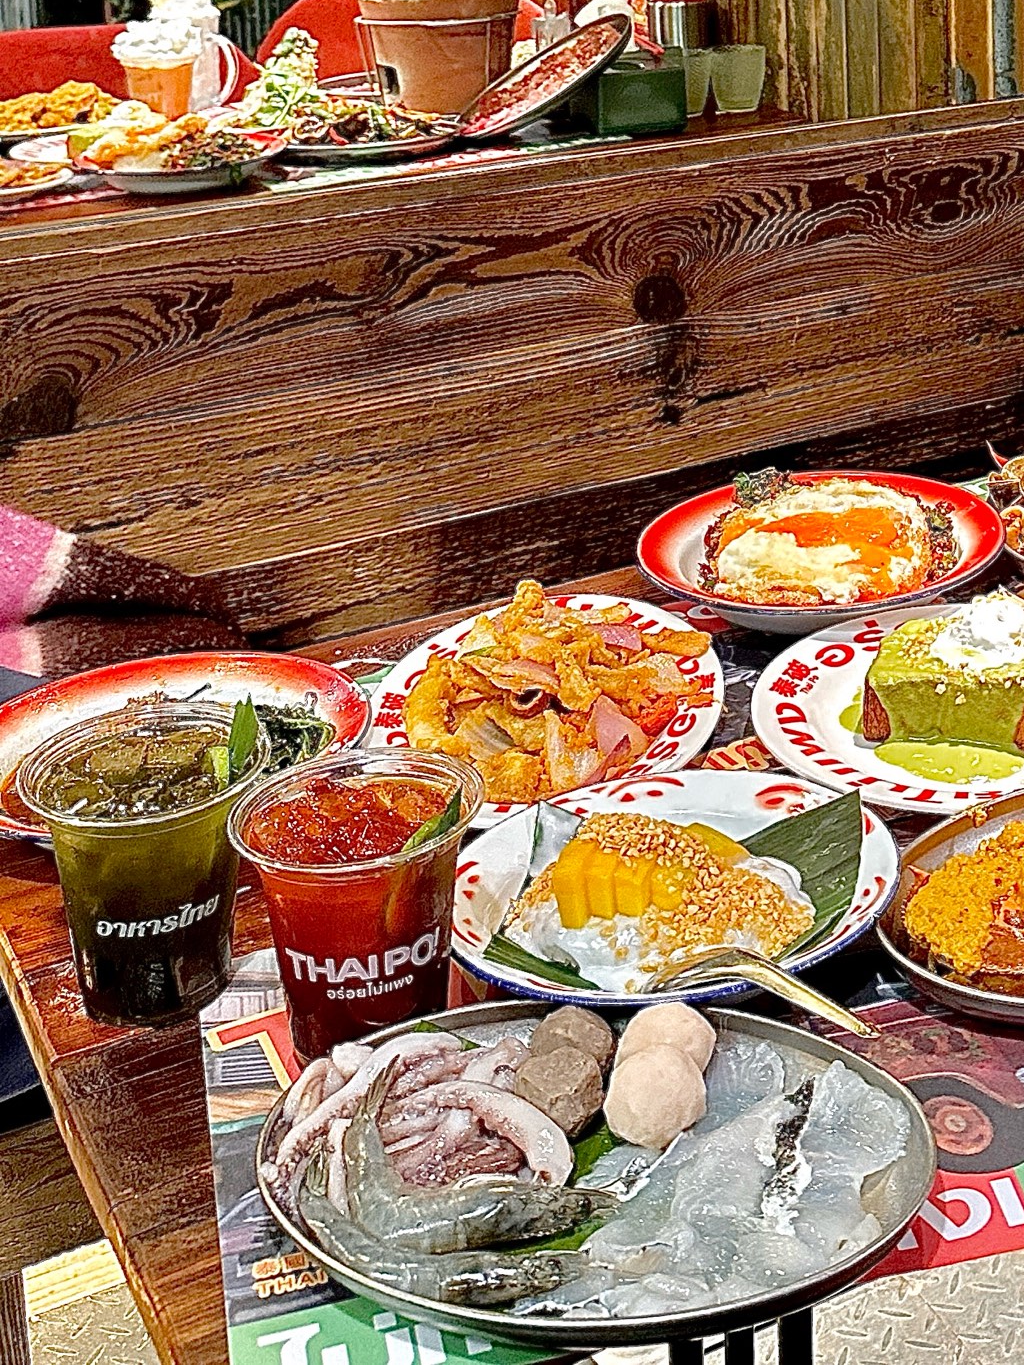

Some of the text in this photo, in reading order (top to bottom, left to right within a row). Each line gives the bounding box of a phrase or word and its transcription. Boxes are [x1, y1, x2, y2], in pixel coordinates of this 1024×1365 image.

[96, 894, 221, 938] อาหารไทย
[326, 974, 415, 1000] อร่อยไม่แพง
